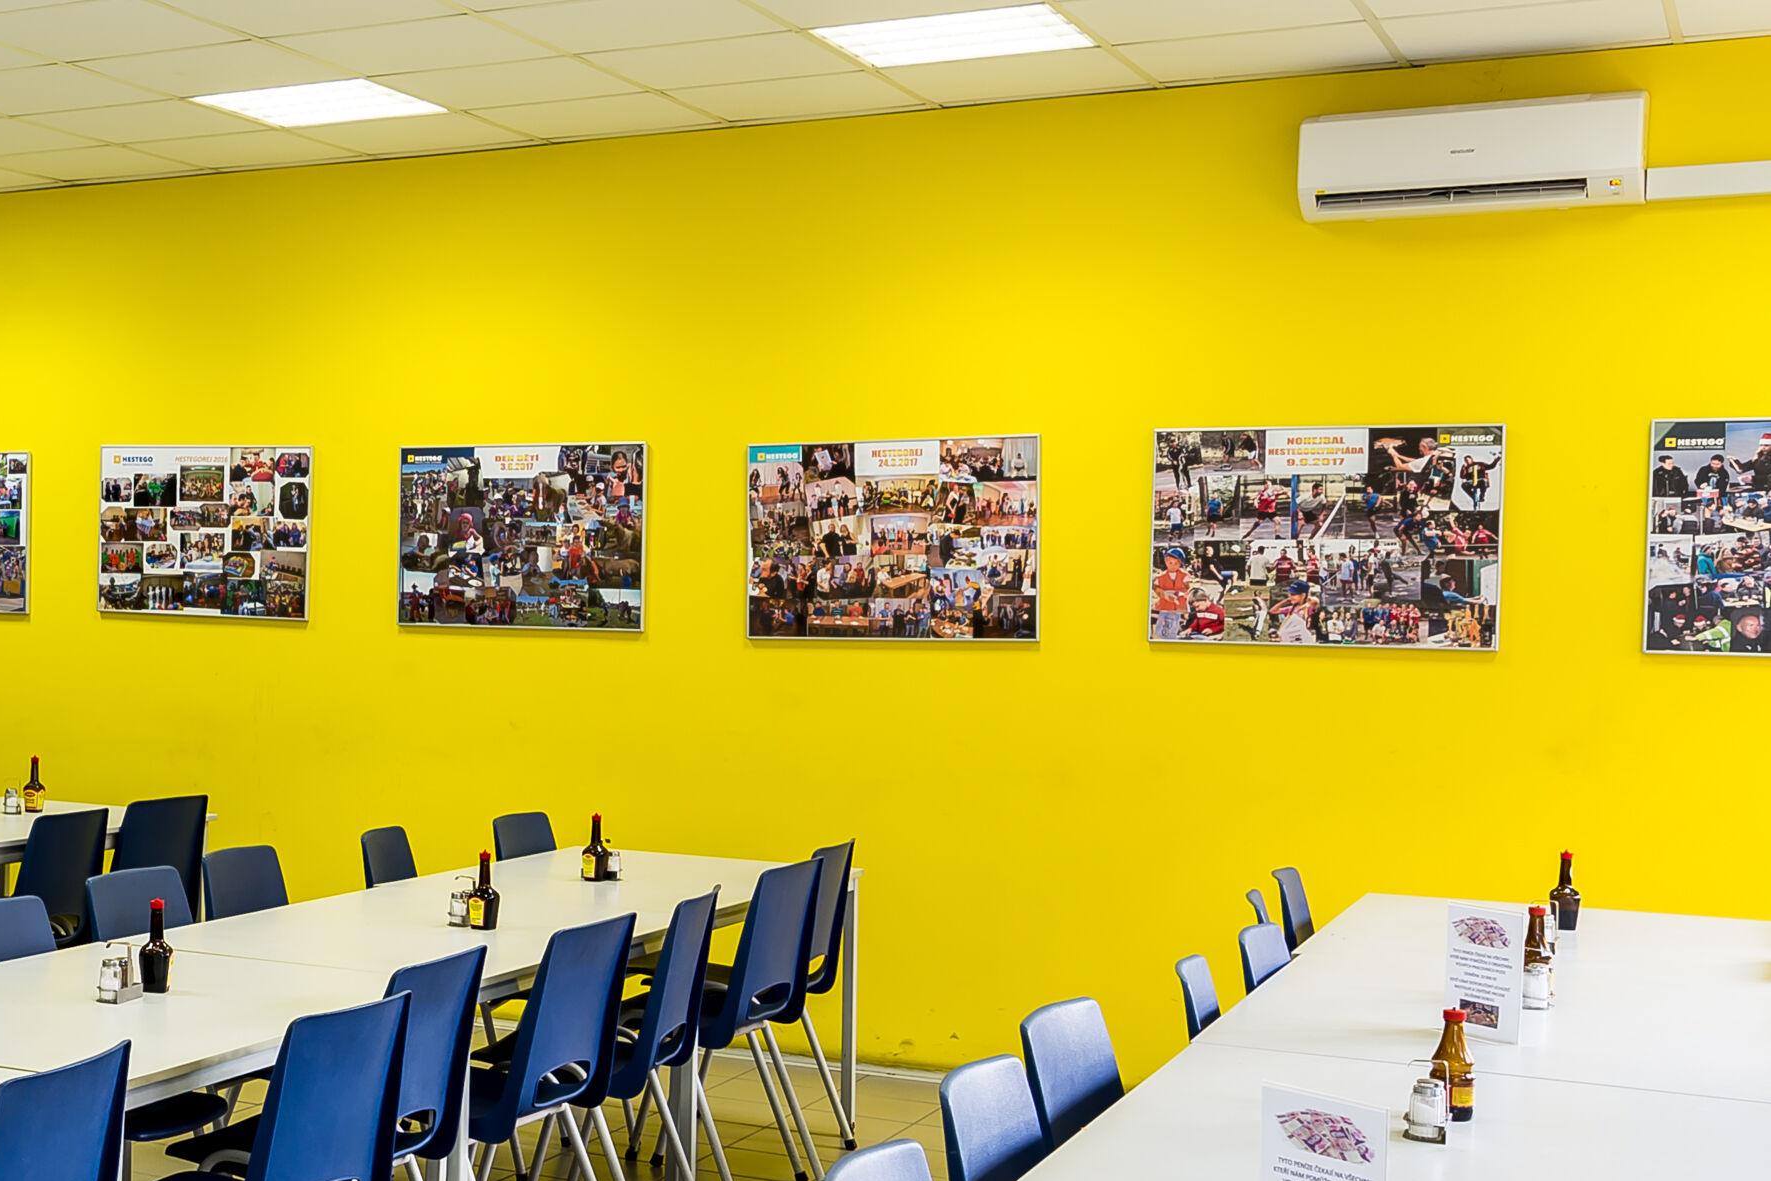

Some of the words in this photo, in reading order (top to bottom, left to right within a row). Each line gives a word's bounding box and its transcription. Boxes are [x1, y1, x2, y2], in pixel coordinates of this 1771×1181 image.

[1287, 436, 1345, 445] NOHEJBAL
[1677, 438, 1725, 446] HESTEGO
[871, 448, 923, 458] HESTEGOREJ
[1268, 446, 1364, 456] HESTEGOOLYMPIÁDA
[1286, 457, 1345, 466] 9.9.2017
[1278, 1156, 1293, 1166] TYTO
[1293, 1160, 1313, 1171] PENÍZE
[1334, 1171, 1343, 1179] NA
[1290, 1170, 1305, 1178] NÁM
